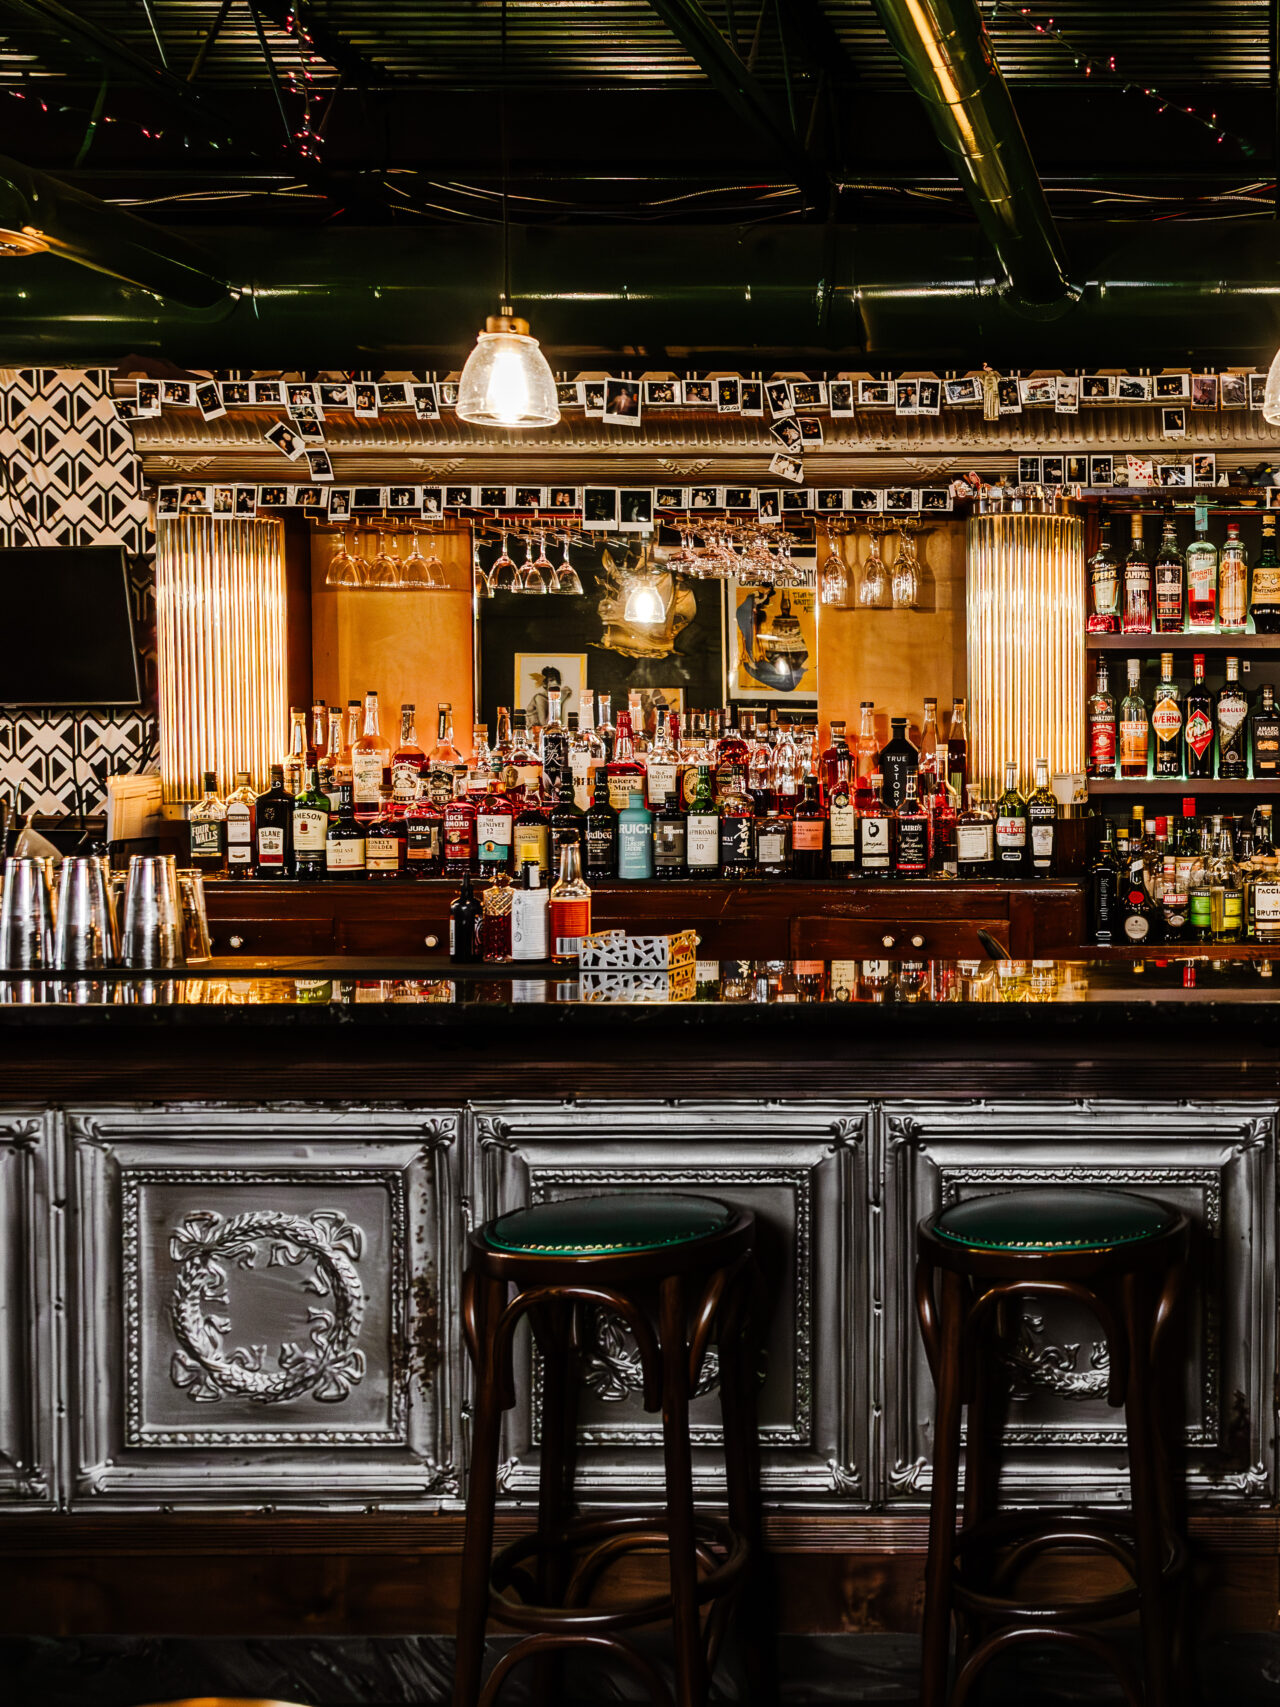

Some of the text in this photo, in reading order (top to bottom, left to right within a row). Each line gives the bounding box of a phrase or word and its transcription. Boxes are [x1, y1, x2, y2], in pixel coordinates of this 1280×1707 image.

[1153, 715, 1181, 723] AVERNA
[1184, 719, 1213, 743] CYNAR
[893, 764, 901, 806] STORY
[192, 824, 210, 837] FOUR
[194, 830, 218, 844] WALLS
[261, 830, 281, 838] SLANE
